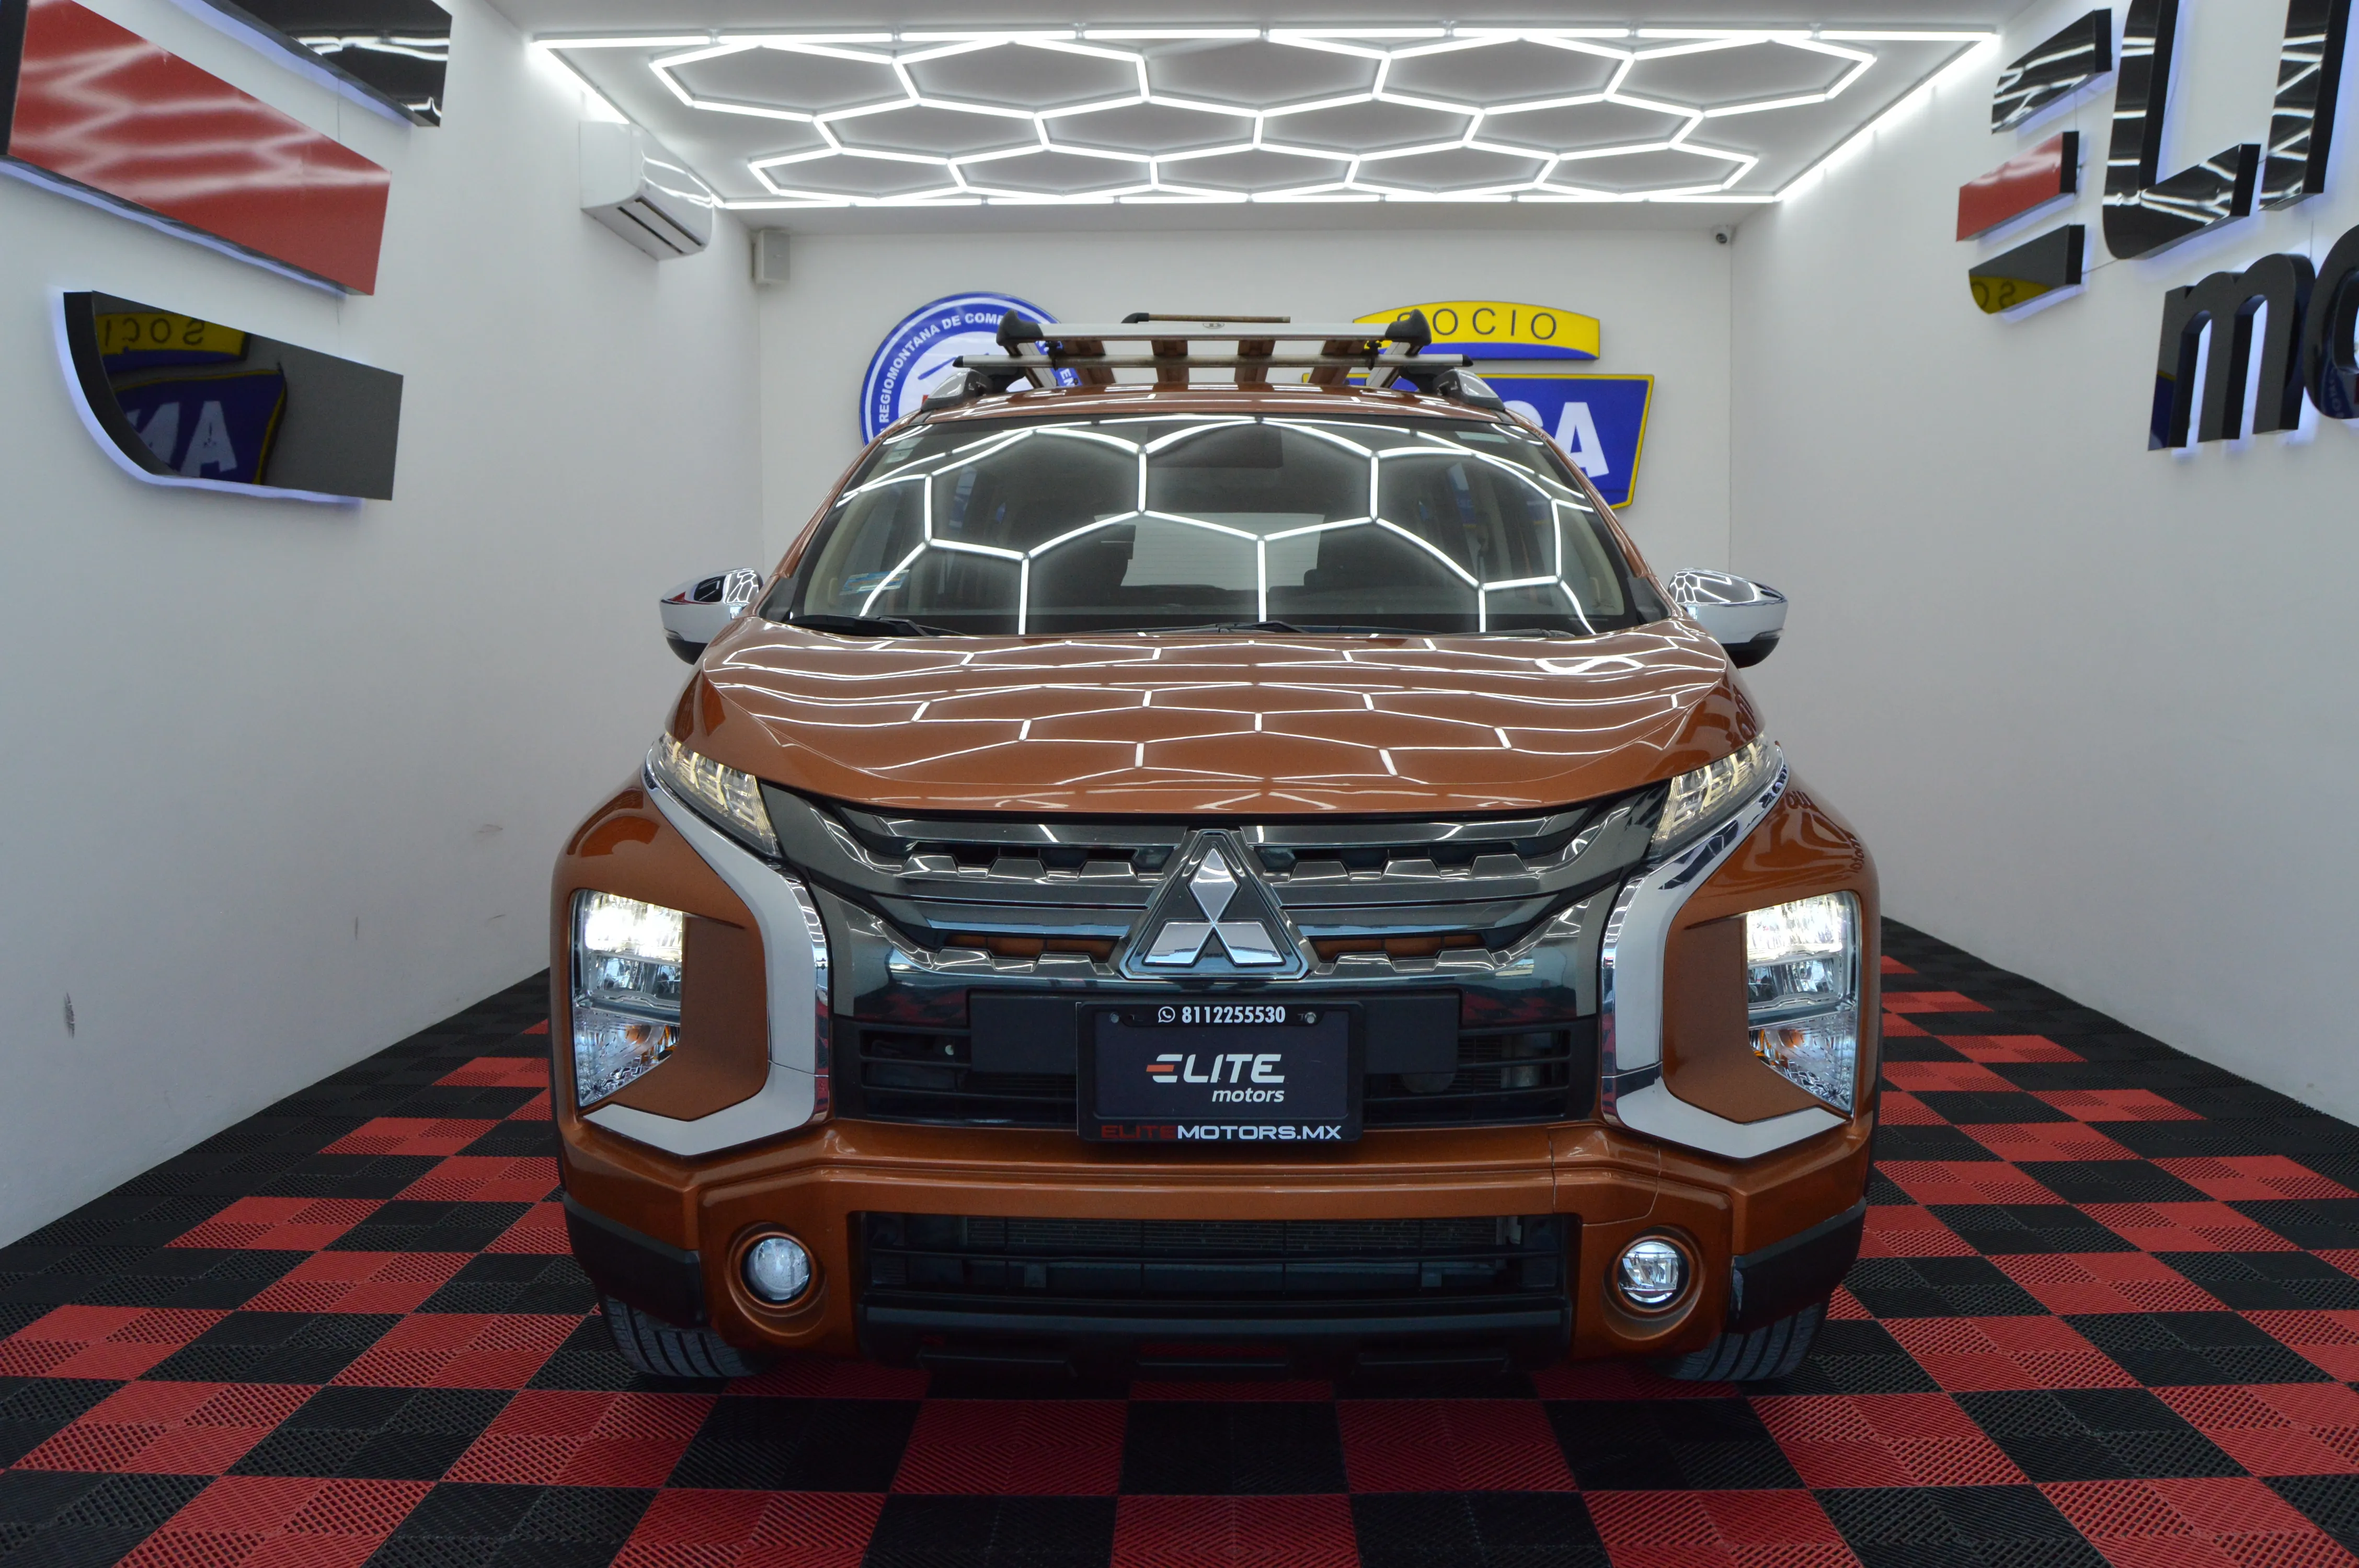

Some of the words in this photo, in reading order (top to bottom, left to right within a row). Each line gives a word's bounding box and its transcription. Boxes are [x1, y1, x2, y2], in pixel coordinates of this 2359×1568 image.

[879, 324, 940, 423] REGIOMONTANA
[942, 315, 961, 330] DE
[1182, 1006, 1286, 1023] 8112255530
[1146, 1054, 1285, 1083] ELITE
[1211, 1088, 1285, 1102] motors
[1102, 1125, 1342, 1139] ELITEMOTORS.MX
